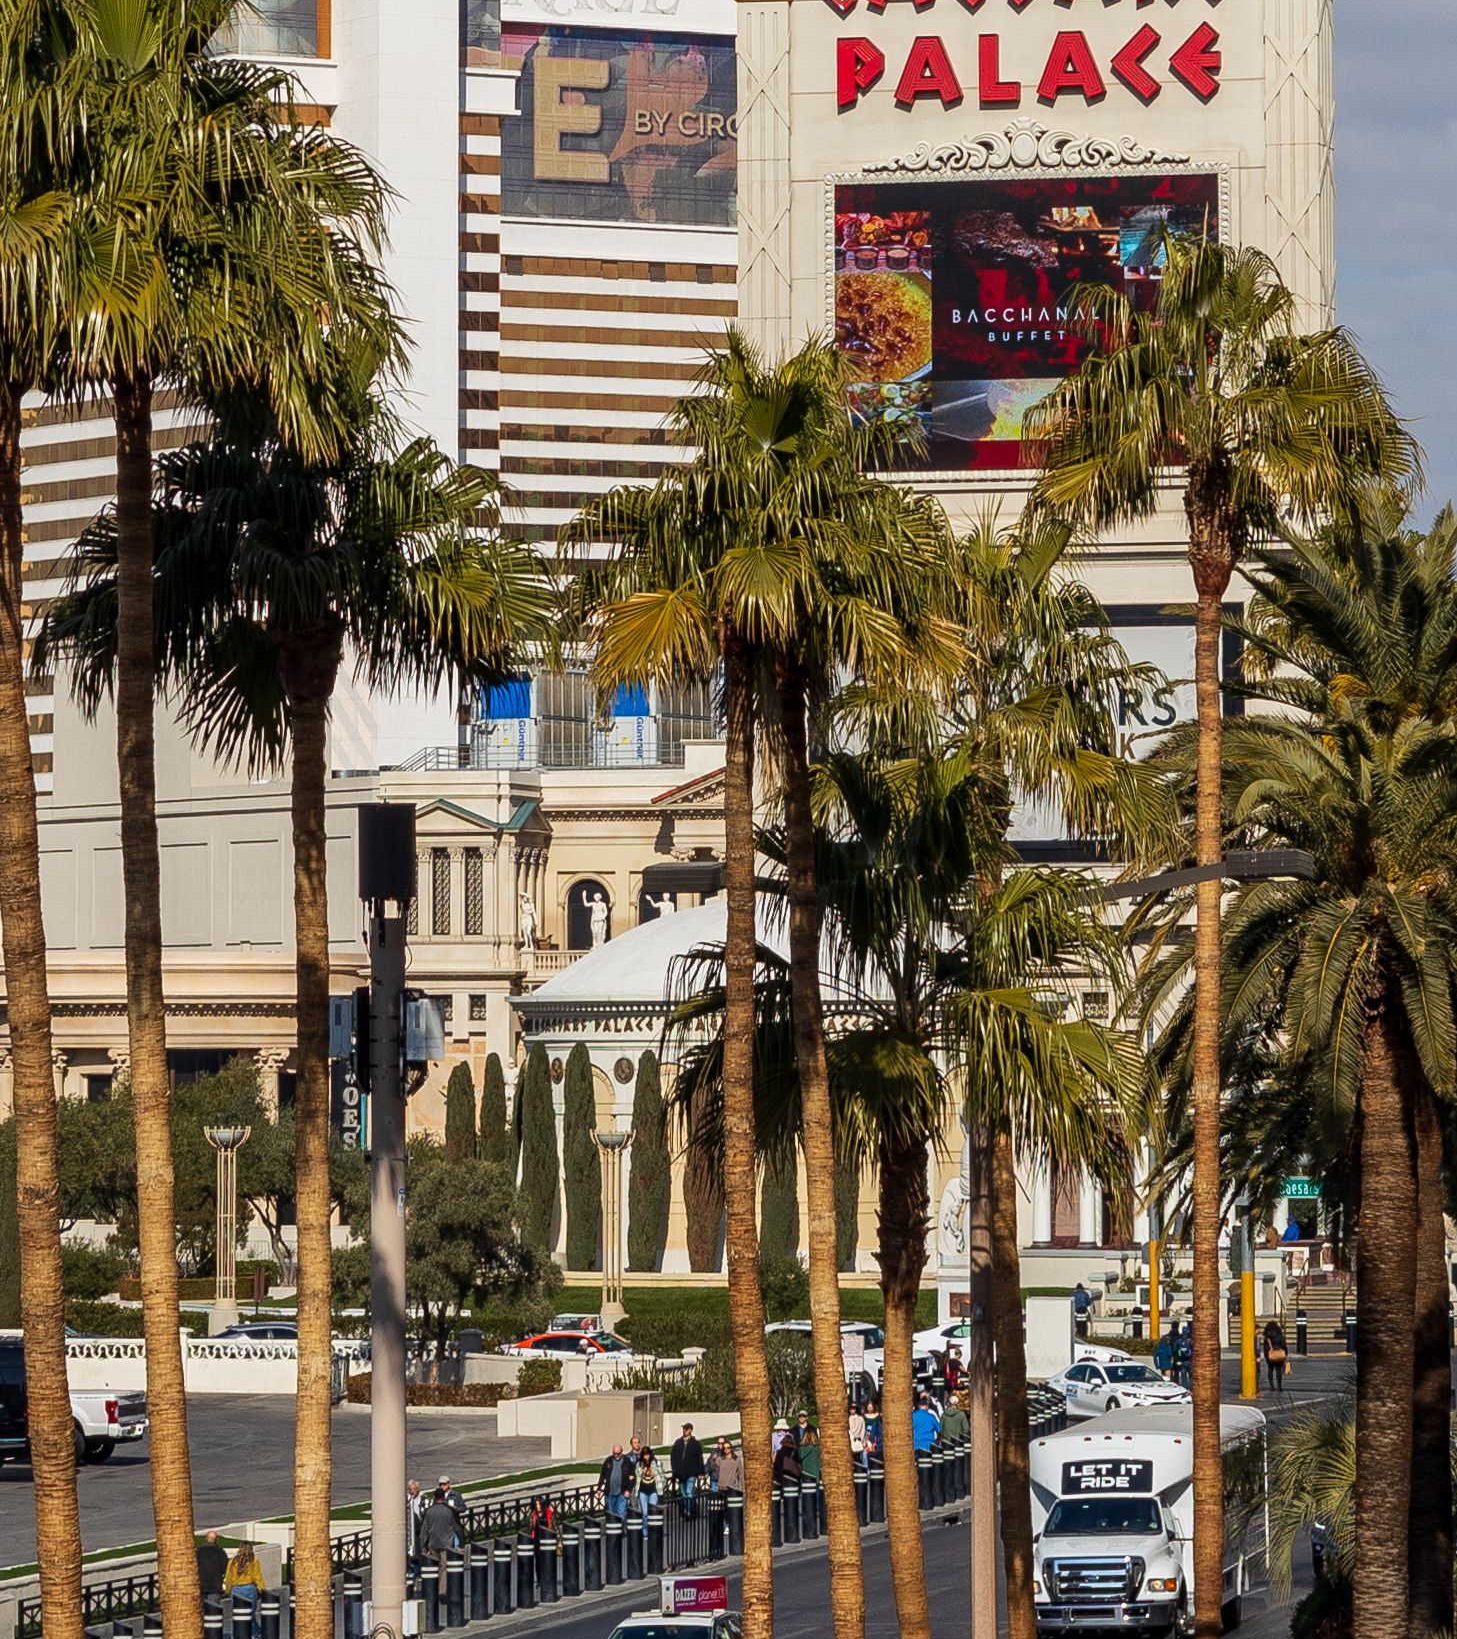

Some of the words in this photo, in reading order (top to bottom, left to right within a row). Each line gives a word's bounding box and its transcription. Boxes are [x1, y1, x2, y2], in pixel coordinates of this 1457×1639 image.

[837, 21, 1221, 116] PALACE
[533, 56, 611, 185] E
[634, 110, 672, 138] BY
[952, 307, 1100, 324] BACCHANAL
[988, 330, 1066, 342] BUFFET
[1281, 1183, 1320, 1195] aesars
[1070, 1464, 1113, 1478] LET
[1120, 1463, 1143, 1476] IT
[1080, 1476, 1130, 1489] RIDE
